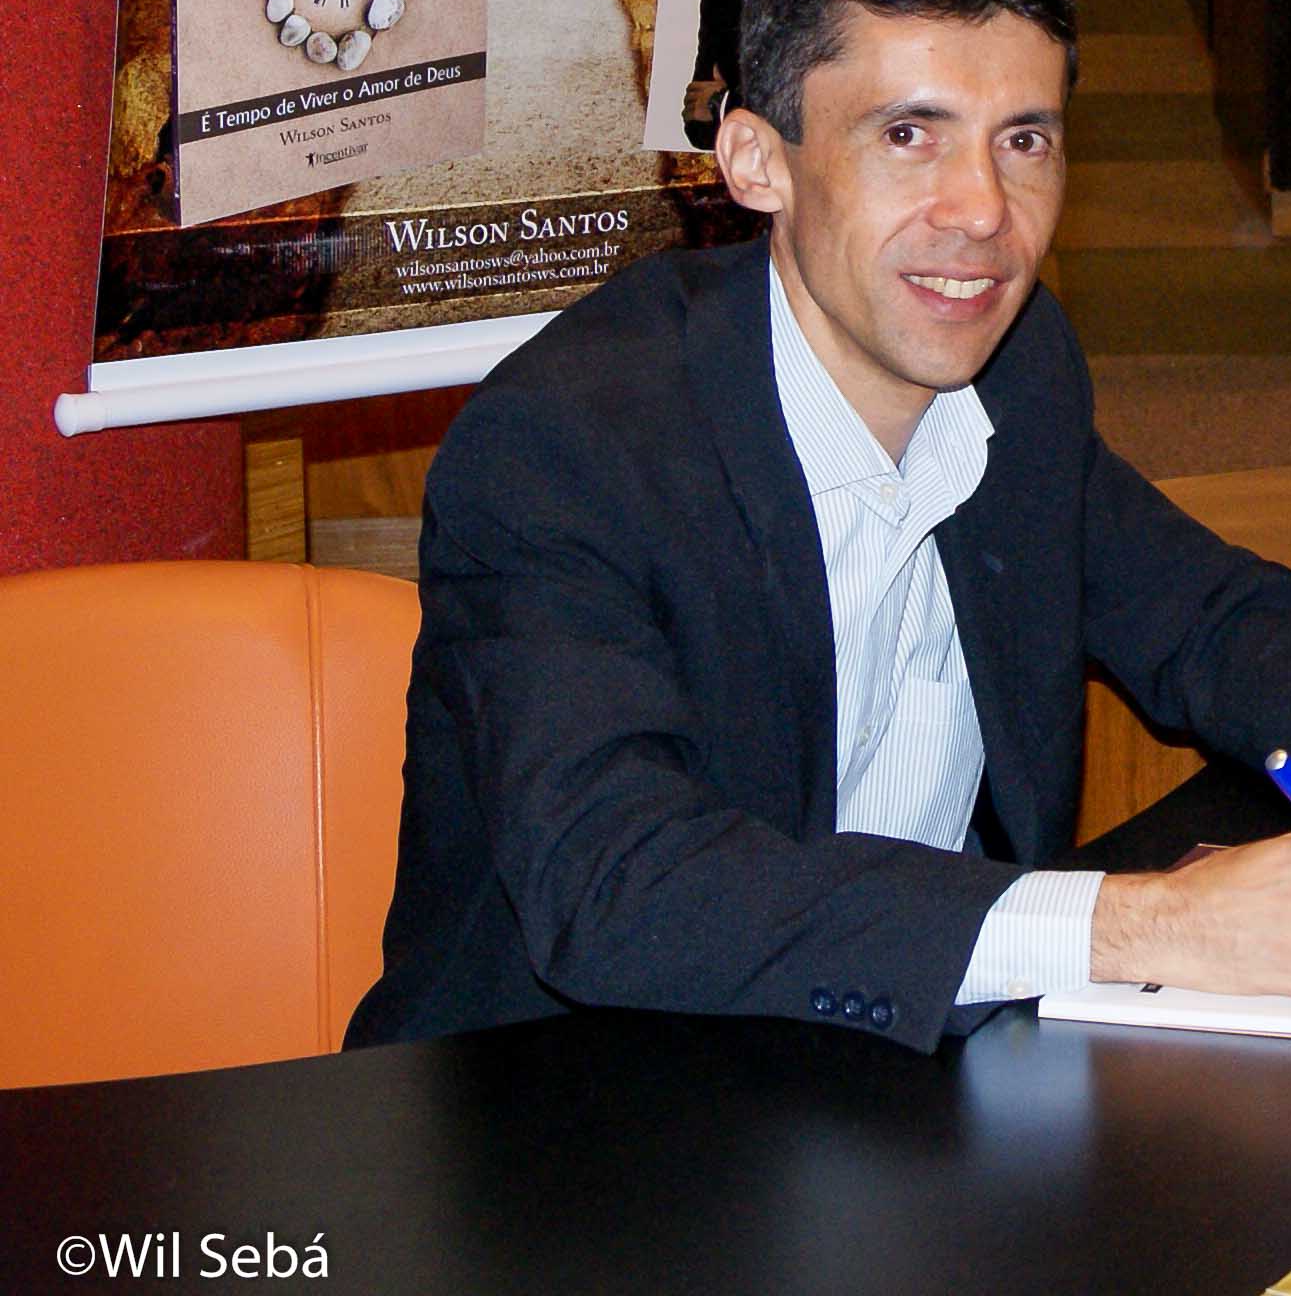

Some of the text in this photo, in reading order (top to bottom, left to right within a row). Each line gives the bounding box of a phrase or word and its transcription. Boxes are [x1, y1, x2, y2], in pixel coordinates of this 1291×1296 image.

[201, 62, 461, 133] É Tempo de Viver o Amor de Deus
[279, 112, 392, 146] WILSON SANTOS
[385, 207, 629, 253] WILSON SANTOS
[396, 241, 620, 278] wilsonsantosws@yahoo.com.br
[402, 261, 610, 296] www.wilsonsantosws.com.br
